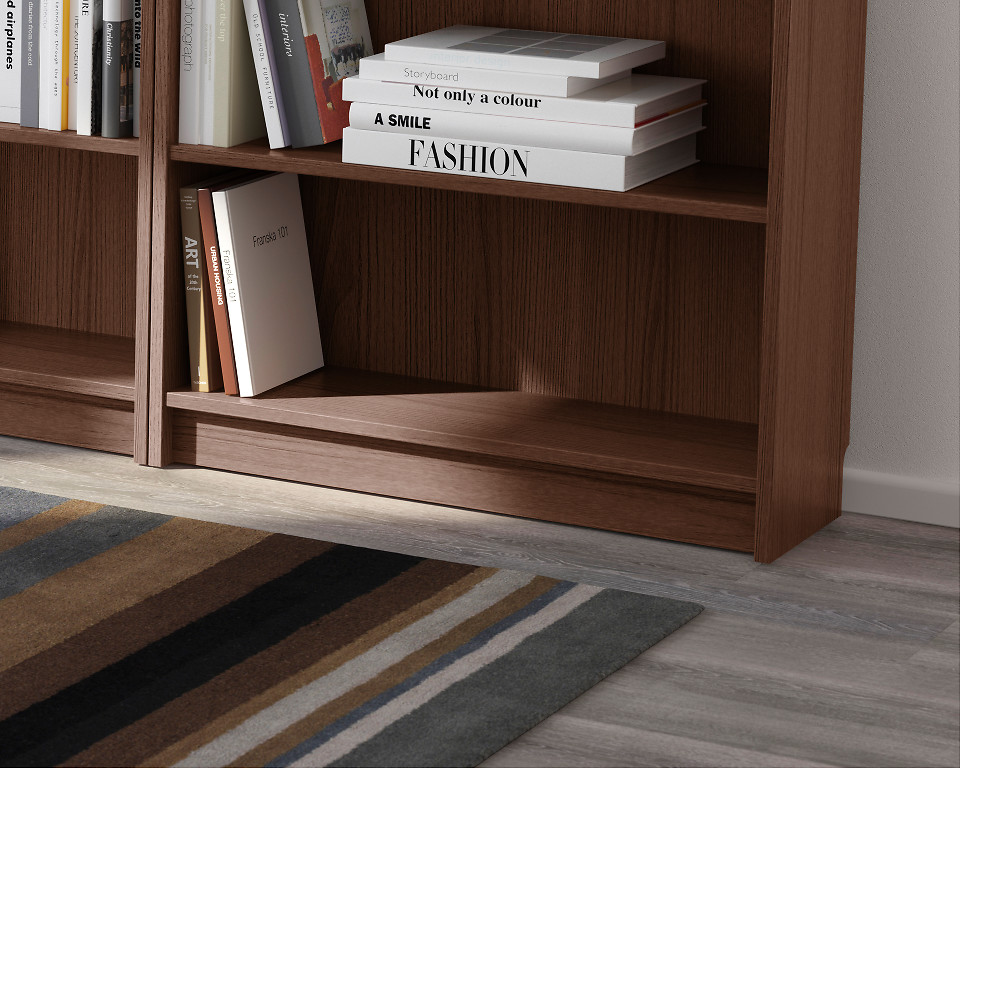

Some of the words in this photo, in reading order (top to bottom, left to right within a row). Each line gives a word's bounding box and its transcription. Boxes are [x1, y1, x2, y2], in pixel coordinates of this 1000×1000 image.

[133, 21, 141, 41] the
[218, 14, 228, 27] the
[4, 11, 16, 70] airplanes
[105, 23, 113, 66] Christianity
[217, 28, 227, 43] top
[278, 12, 295, 58] interiors
[133, 43, 141, 69] wild
[255, 33, 265, 62] SCHOOL
[261, 67, 276, 110] FURNITURE
[403, 67, 459, 82] Storyboard
[412, 84, 440, 99] Not
[443, 89, 476, 105] only
[480, 95, 489, 104] a
[492, 94, 542, 108] colour
[374, 112, 384, 125] A
[387, 114, 432, 130] SMILE
[407, 138, 531, 177] FASHION
[252, 231, 277, 248] Franska
[277, 225, 289, 239] 101
[184, 236, 200, 268] ART
[209, 245, 219, 271] URBAN
[221, 248, 233, 284] Franska
[227, 287, 237, 302] 101
[213, 272, 224, 306] HOUSING
